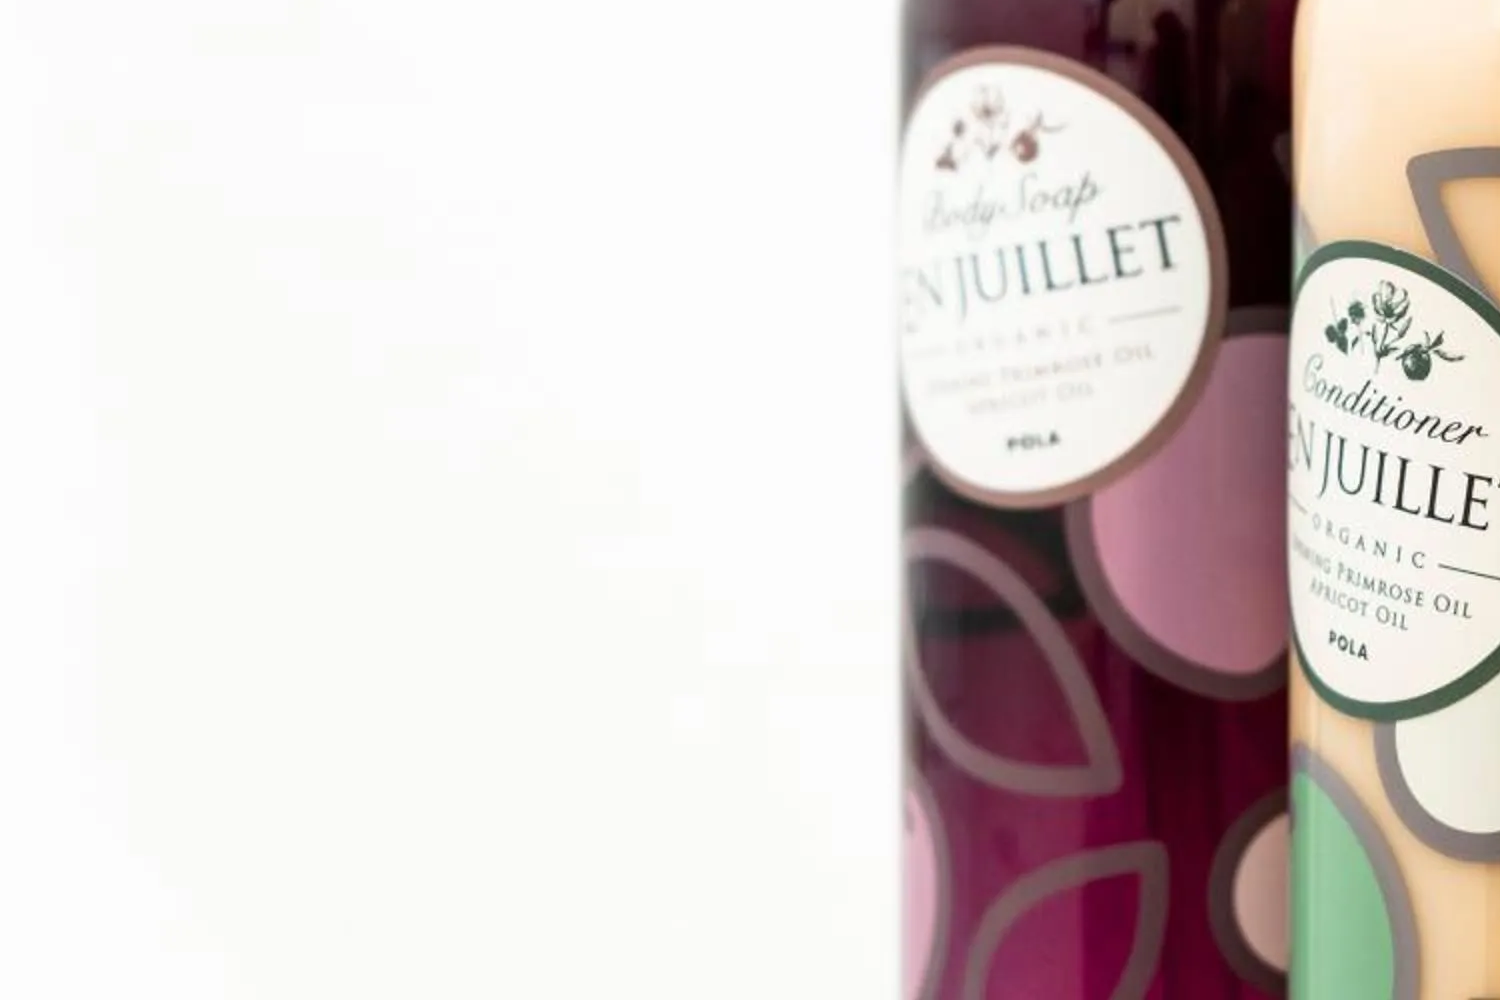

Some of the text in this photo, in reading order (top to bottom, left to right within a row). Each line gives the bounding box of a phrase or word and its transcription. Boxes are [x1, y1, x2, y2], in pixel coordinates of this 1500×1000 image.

[1009, 171, 1103, 223] Soap
[954, 214, 1182, 322] JUILLET
[1302, 352, 1490, 445] Conditioner
[1311, 512, 1427, 569] ORGANIC
[1337, 561, 1425, 607] PRIMROSE
[1433, 592, 1474, 620] OIL
[1328, 628, 1370, 660] POLA
